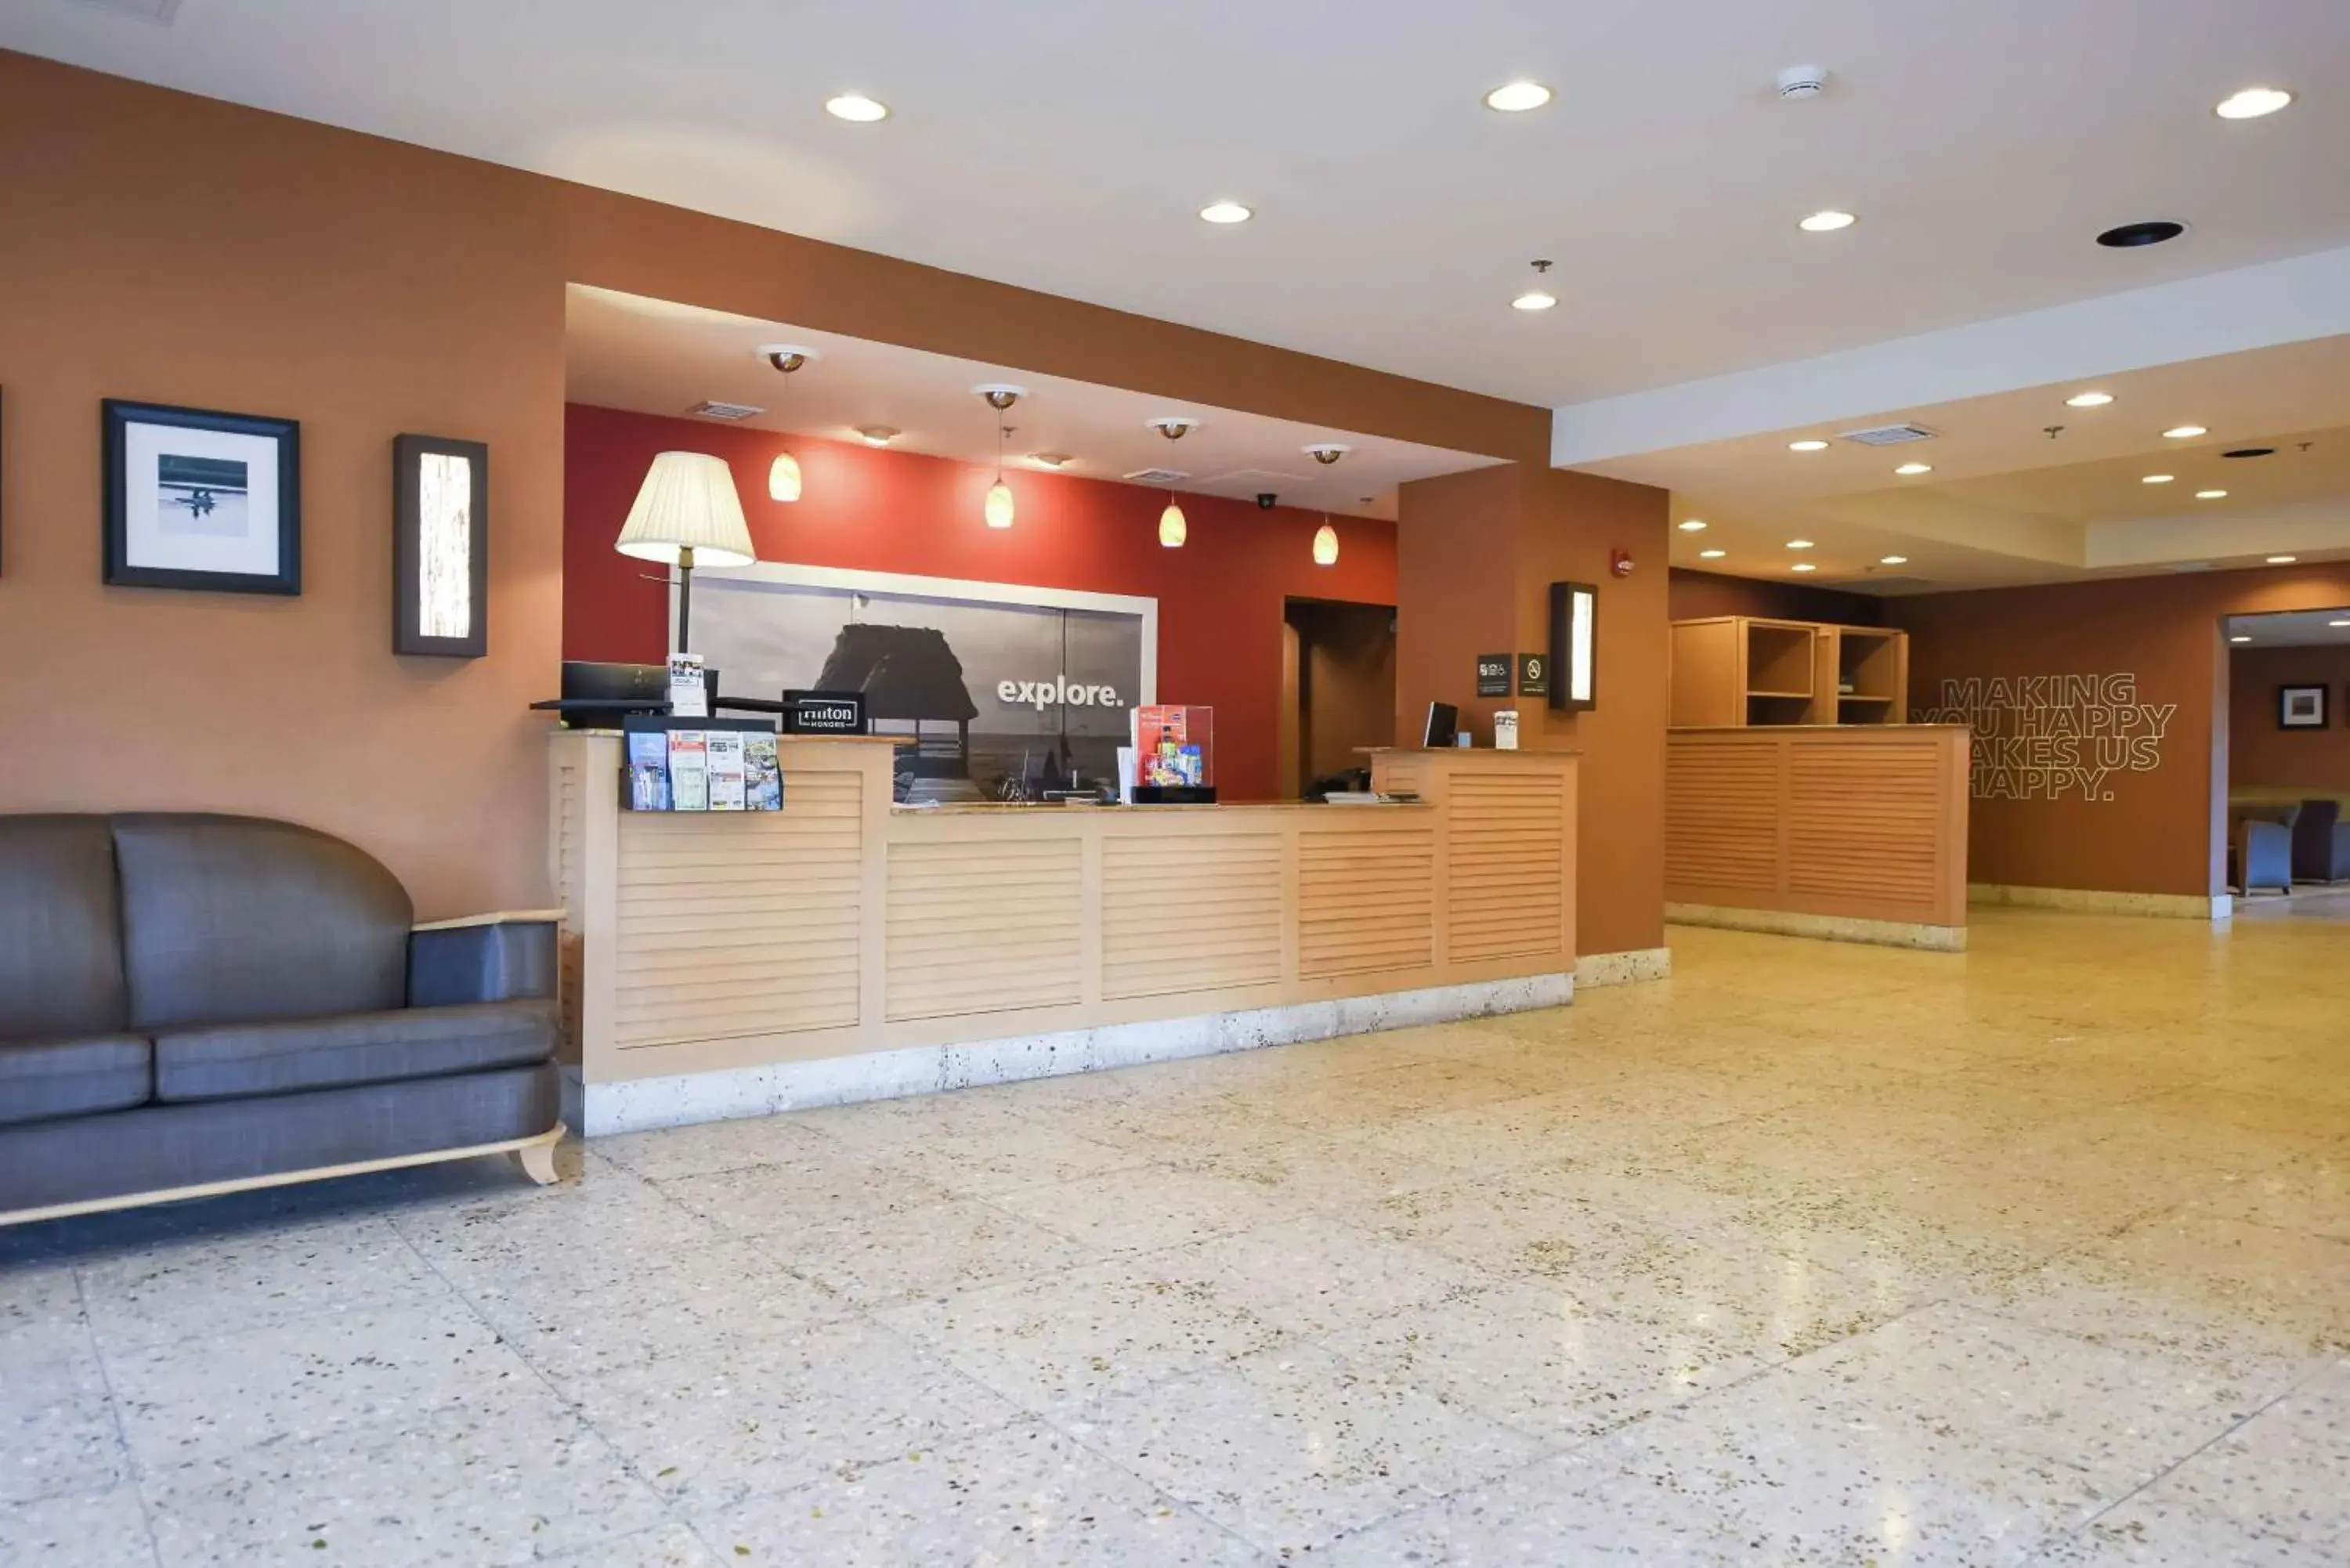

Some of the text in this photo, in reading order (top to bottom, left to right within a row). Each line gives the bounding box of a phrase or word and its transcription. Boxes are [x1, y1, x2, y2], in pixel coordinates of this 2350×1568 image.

[996, 674, 1124, 711] explore.
[1940, 673, 2136, 709] MAKING
[2014, 704, 2178, 739] HAPPY
[1969, 735, 2161, 771] AKES US
